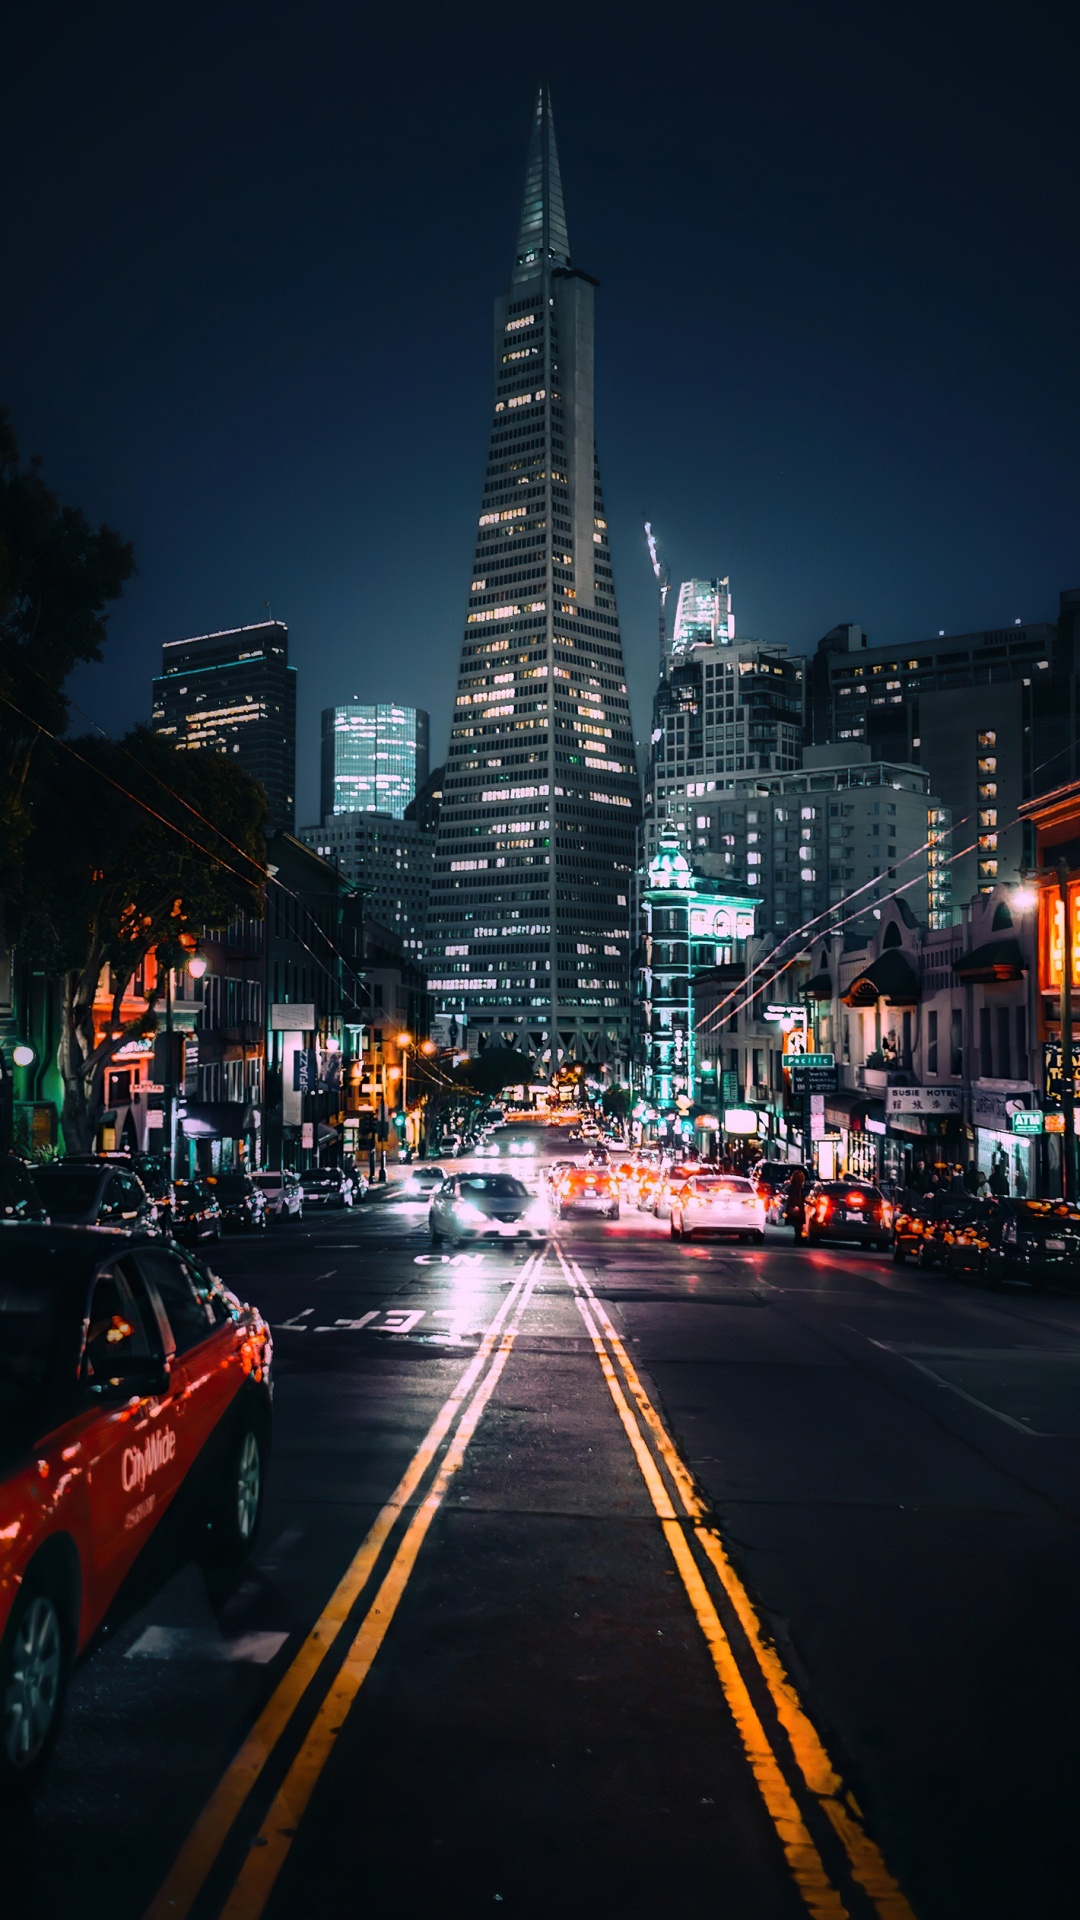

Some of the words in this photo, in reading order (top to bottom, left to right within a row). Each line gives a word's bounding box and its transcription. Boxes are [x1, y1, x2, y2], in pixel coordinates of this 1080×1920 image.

[299, 1049, 309, 1093] SFJAZZ
[1015, 1114, 1040, 1125] ATM
[121, 1423, 176, 1492] CityWide
